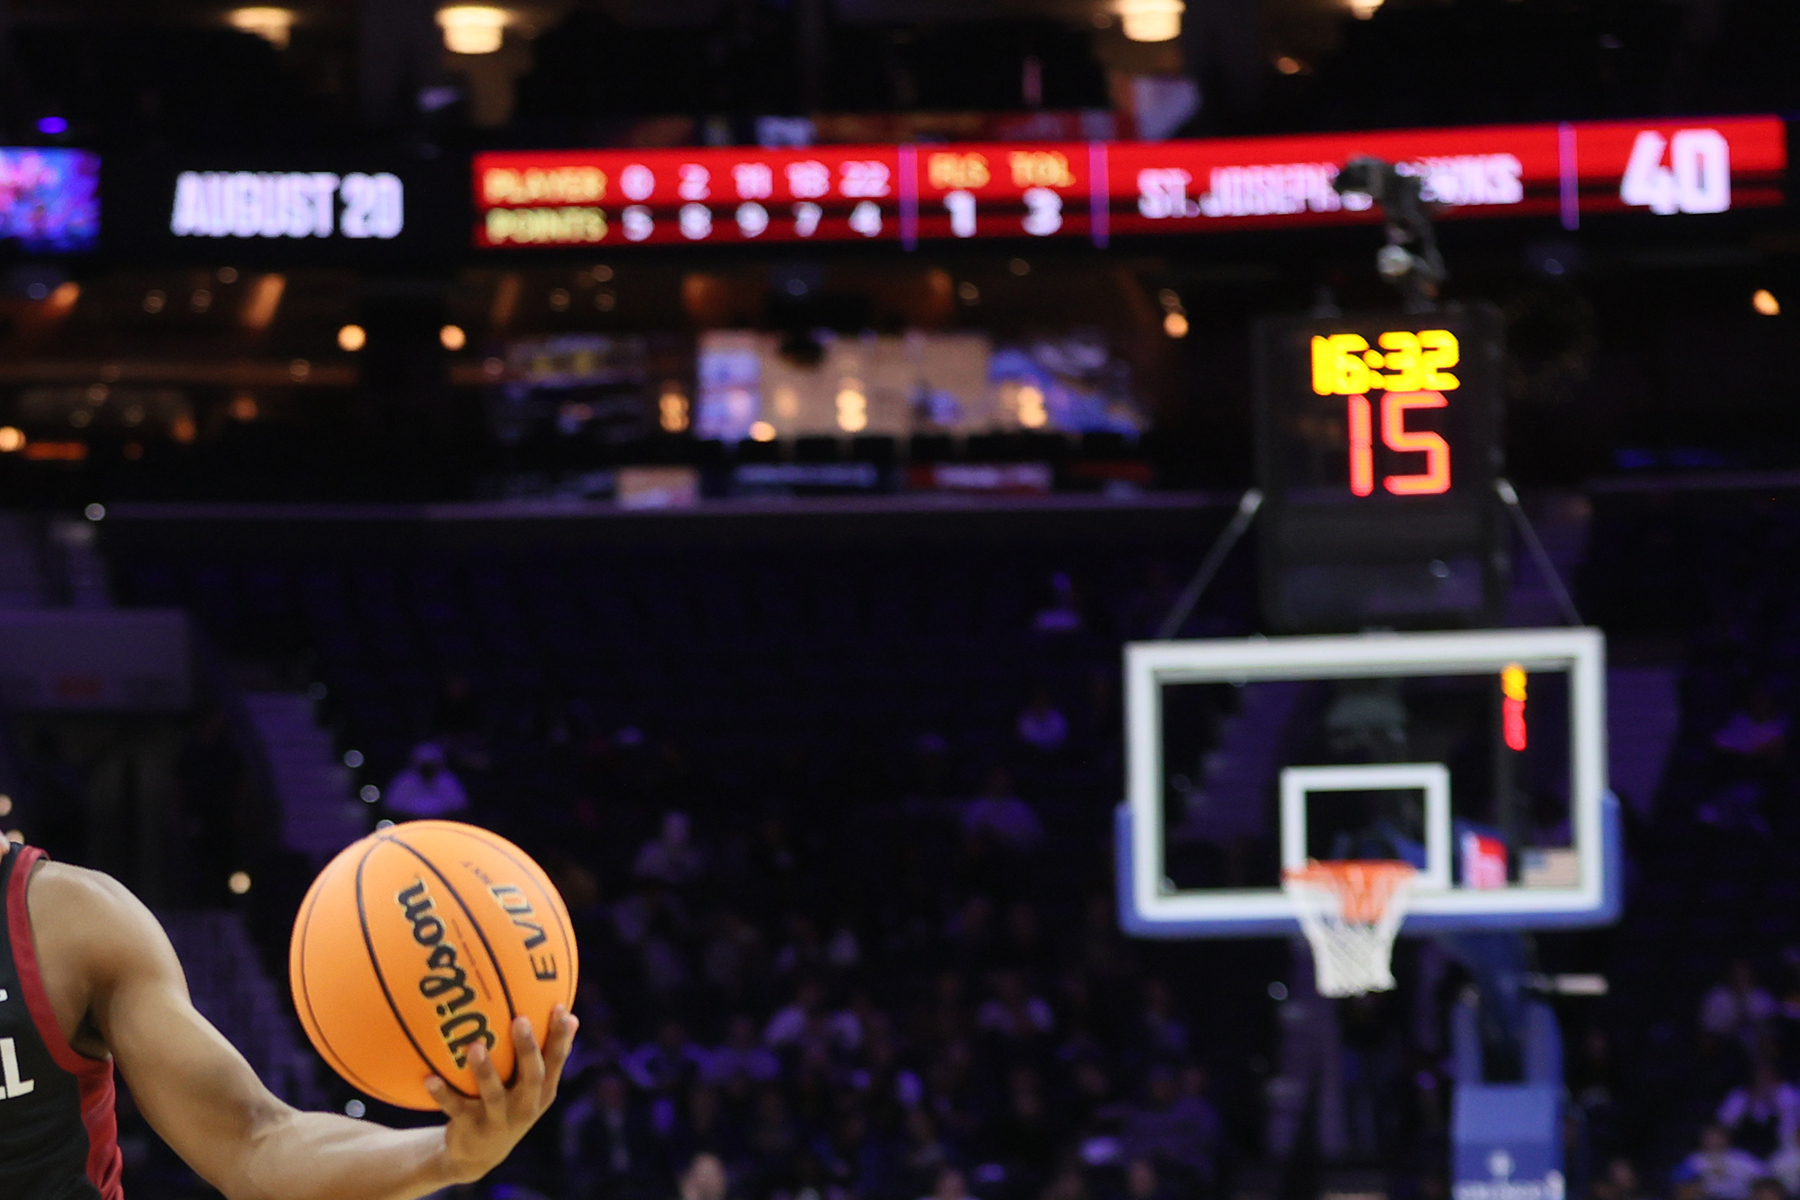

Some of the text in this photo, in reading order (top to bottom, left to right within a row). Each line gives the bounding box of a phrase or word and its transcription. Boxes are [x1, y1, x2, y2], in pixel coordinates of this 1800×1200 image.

[170, 170, 340, 238] AUGUST
[678, 163, 711, 201] 2
[839, 160, 891, 198] 22
[1138, 167, 1200, 218] ST.
[1200, 161, 1372, 216] JOSEPH
[1620, 128, 1732, 216] 40
[944, 187, 1063, 238] 1 3
[1311, 329, 1460, 396] 16:32
[1348, 390, 1452, 497] 15
[489, 883, 559, 982] EVO
[396, 877, 496, 1069] Wilson
